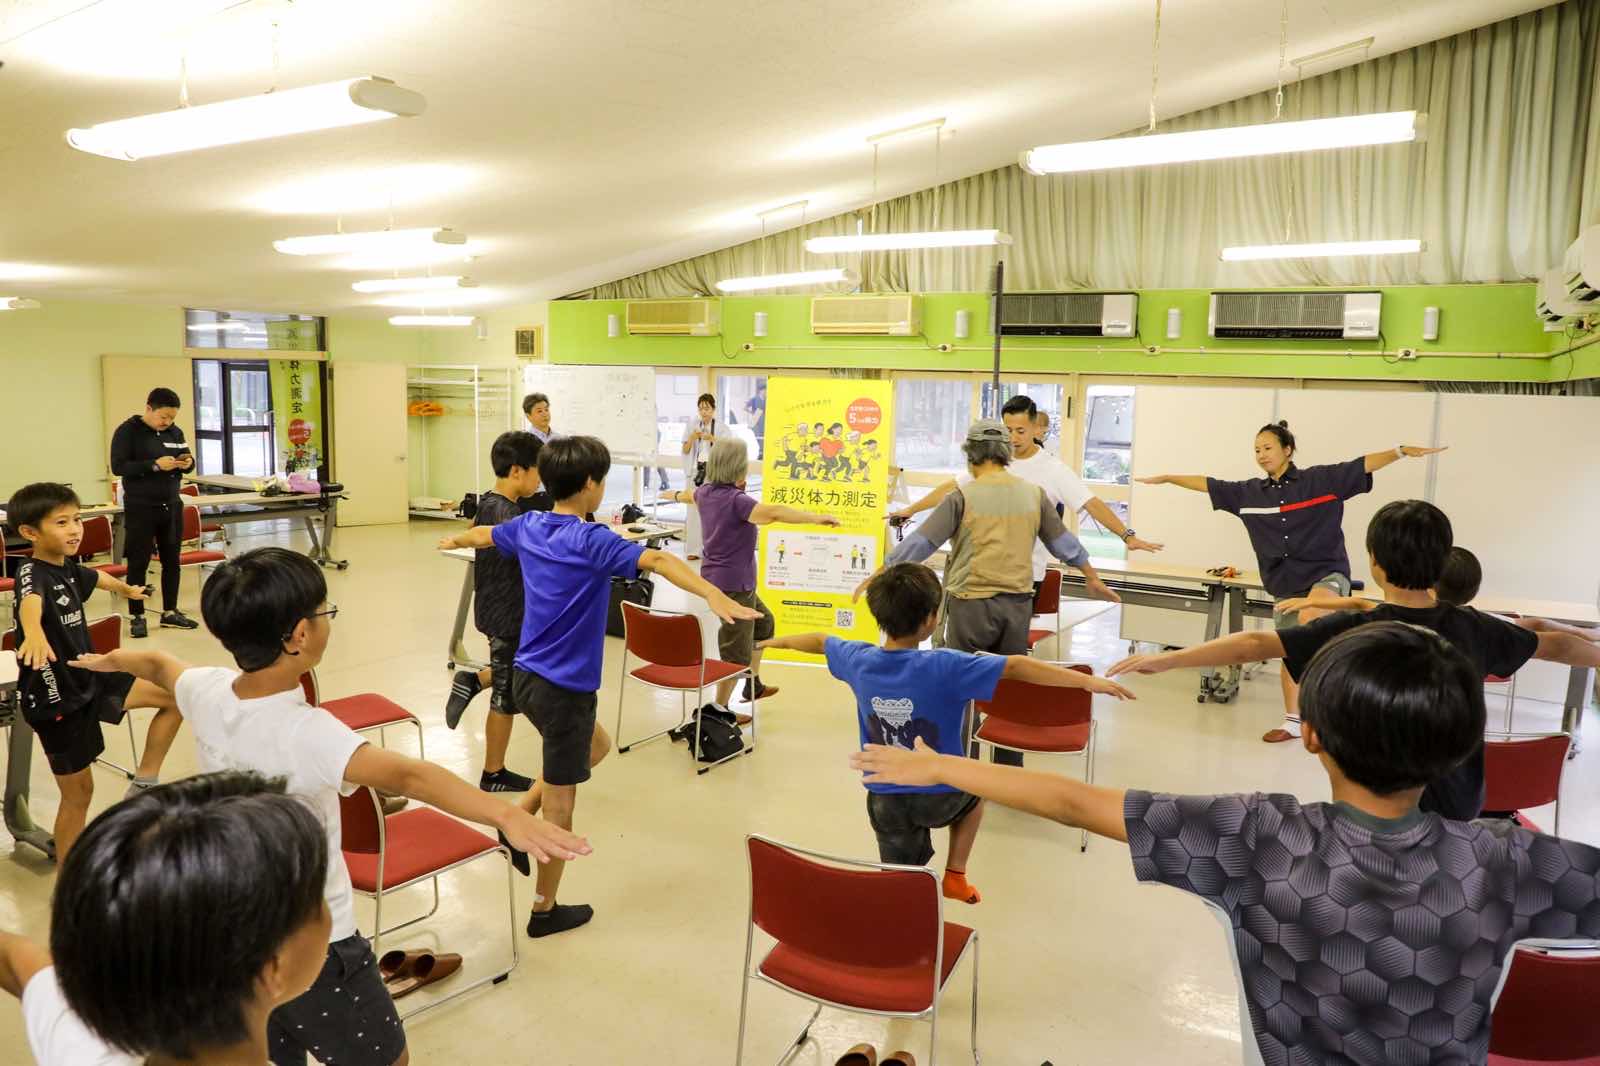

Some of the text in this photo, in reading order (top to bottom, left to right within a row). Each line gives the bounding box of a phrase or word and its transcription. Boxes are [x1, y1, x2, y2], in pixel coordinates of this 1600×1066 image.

[771, 487, 877, 508] 減災体力測定
